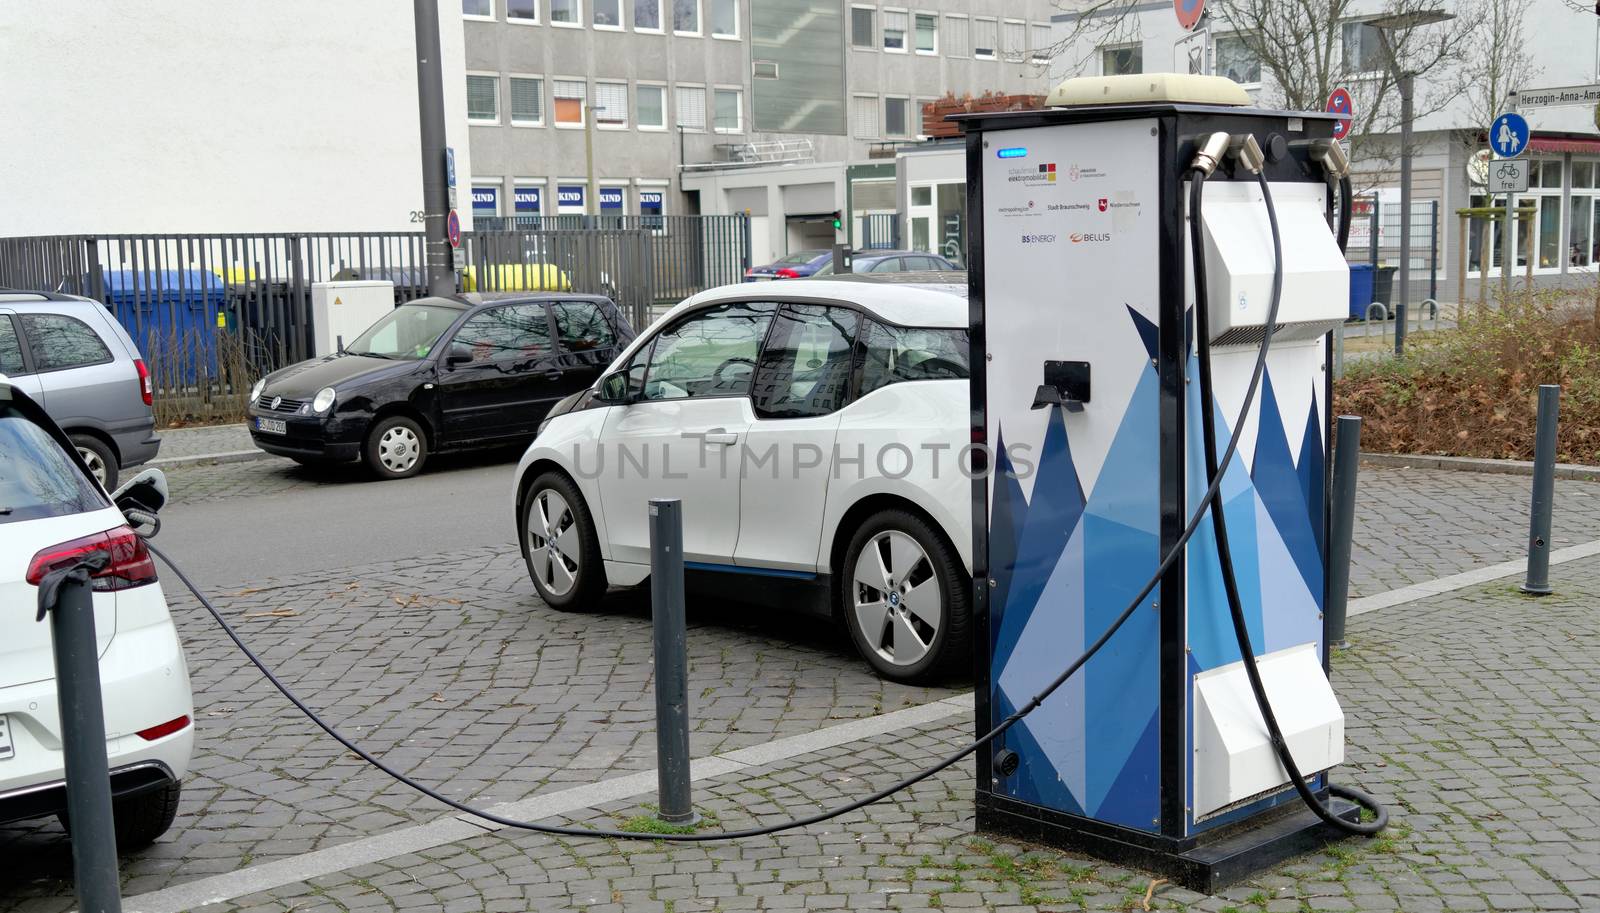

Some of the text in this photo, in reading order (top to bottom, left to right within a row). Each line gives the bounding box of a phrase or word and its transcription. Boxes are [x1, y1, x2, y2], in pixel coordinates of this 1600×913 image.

[1501, 181, 1516, 190] frei
[471, 193, 494, 202] KIND
[515, 193, 538, 202] KIND
[559, 191, 581, 202] KIND
[600, 194, 621, 203] KIND
[640, 194, 661, 203] KIND
[410, 211, 425, 223] 29
[1083, 233, 1110, 242] BELLIS
